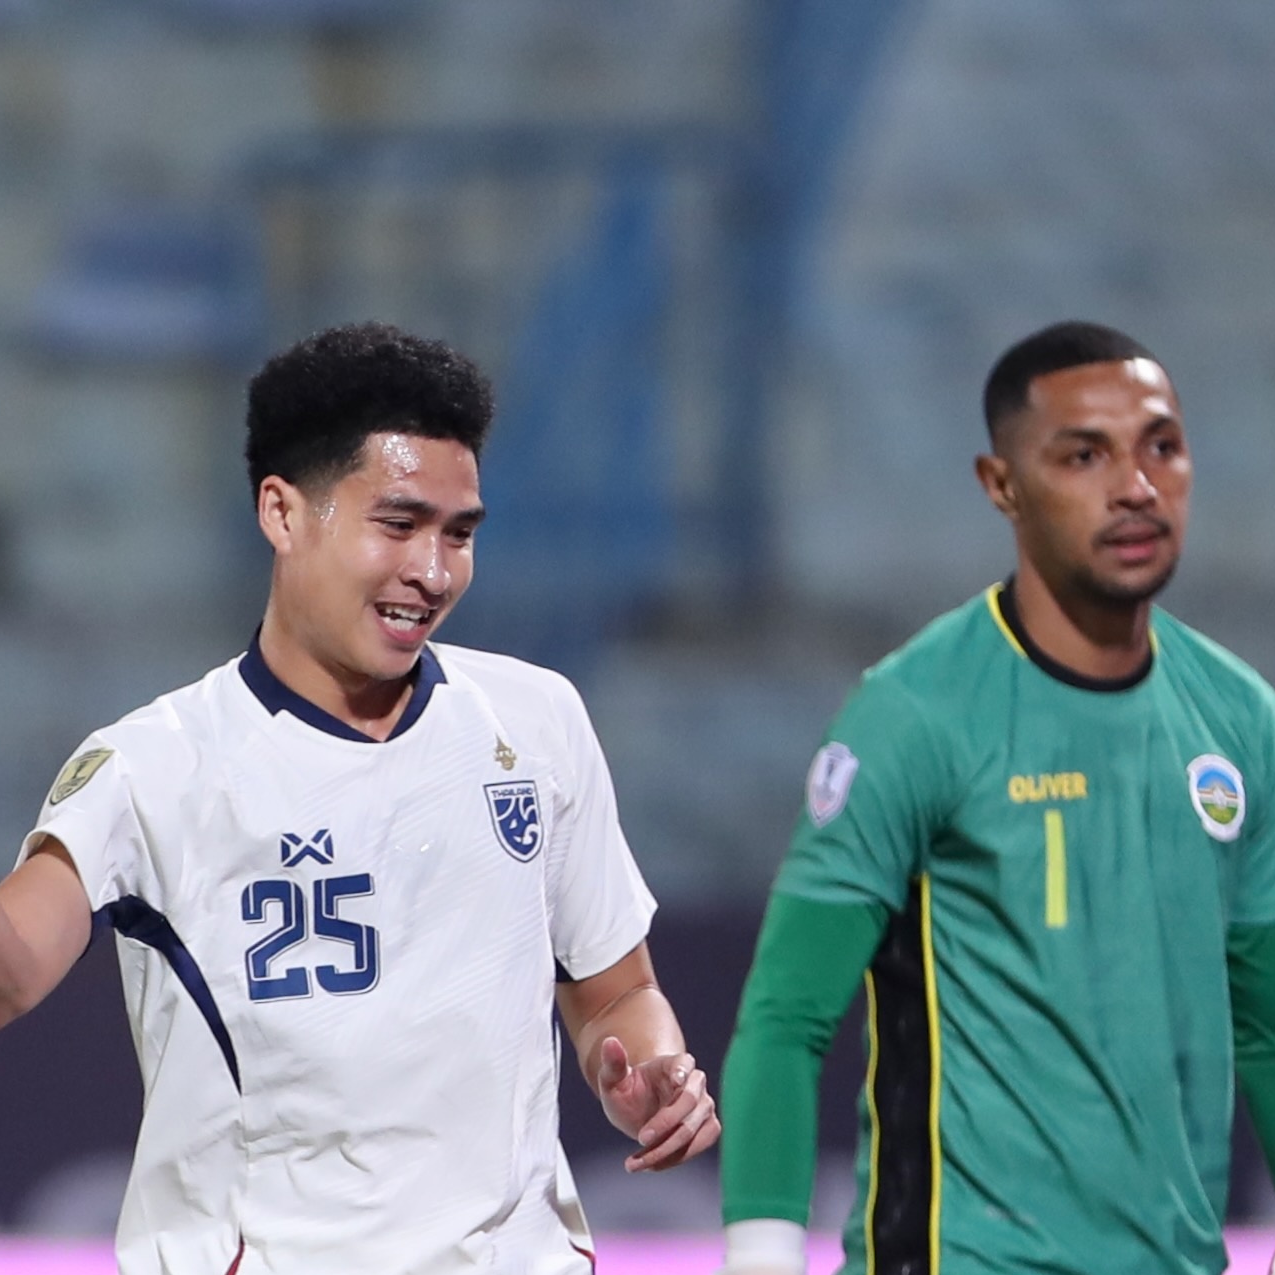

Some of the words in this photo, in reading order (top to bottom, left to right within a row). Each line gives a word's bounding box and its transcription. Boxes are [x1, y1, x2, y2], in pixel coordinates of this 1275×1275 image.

[1008, 772, 1087, 803] OLIVER
[1044, 808, 1067, 929] 1
[241, 872, 380, 1004] 25
